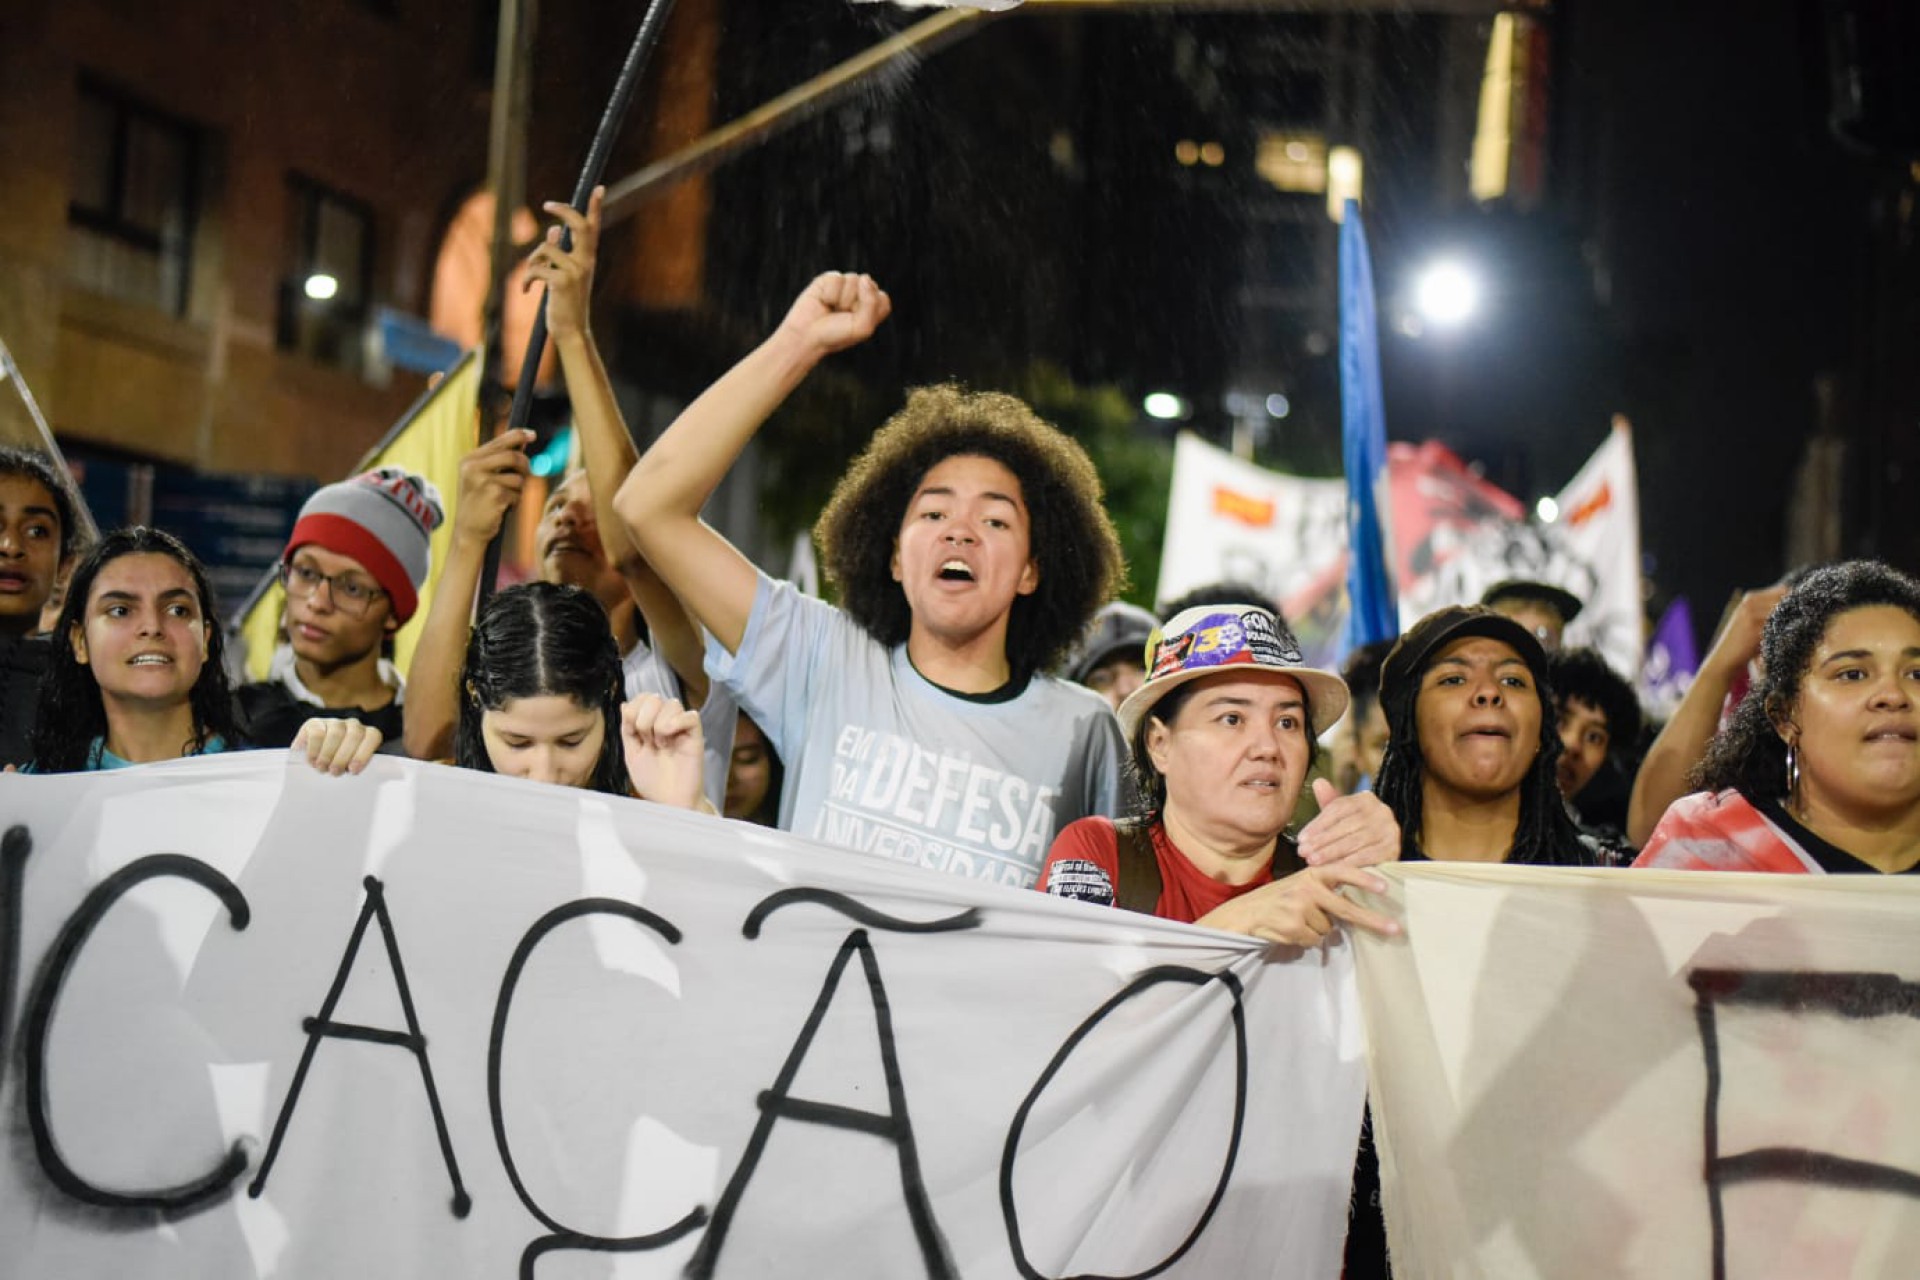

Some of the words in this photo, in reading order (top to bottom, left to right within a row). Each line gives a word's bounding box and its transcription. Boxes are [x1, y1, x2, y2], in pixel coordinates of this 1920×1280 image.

[831, 763, 860, 802] DA
[837, 724, 876, 762] EM
[859, 732, 1062, 862] DEFESA
